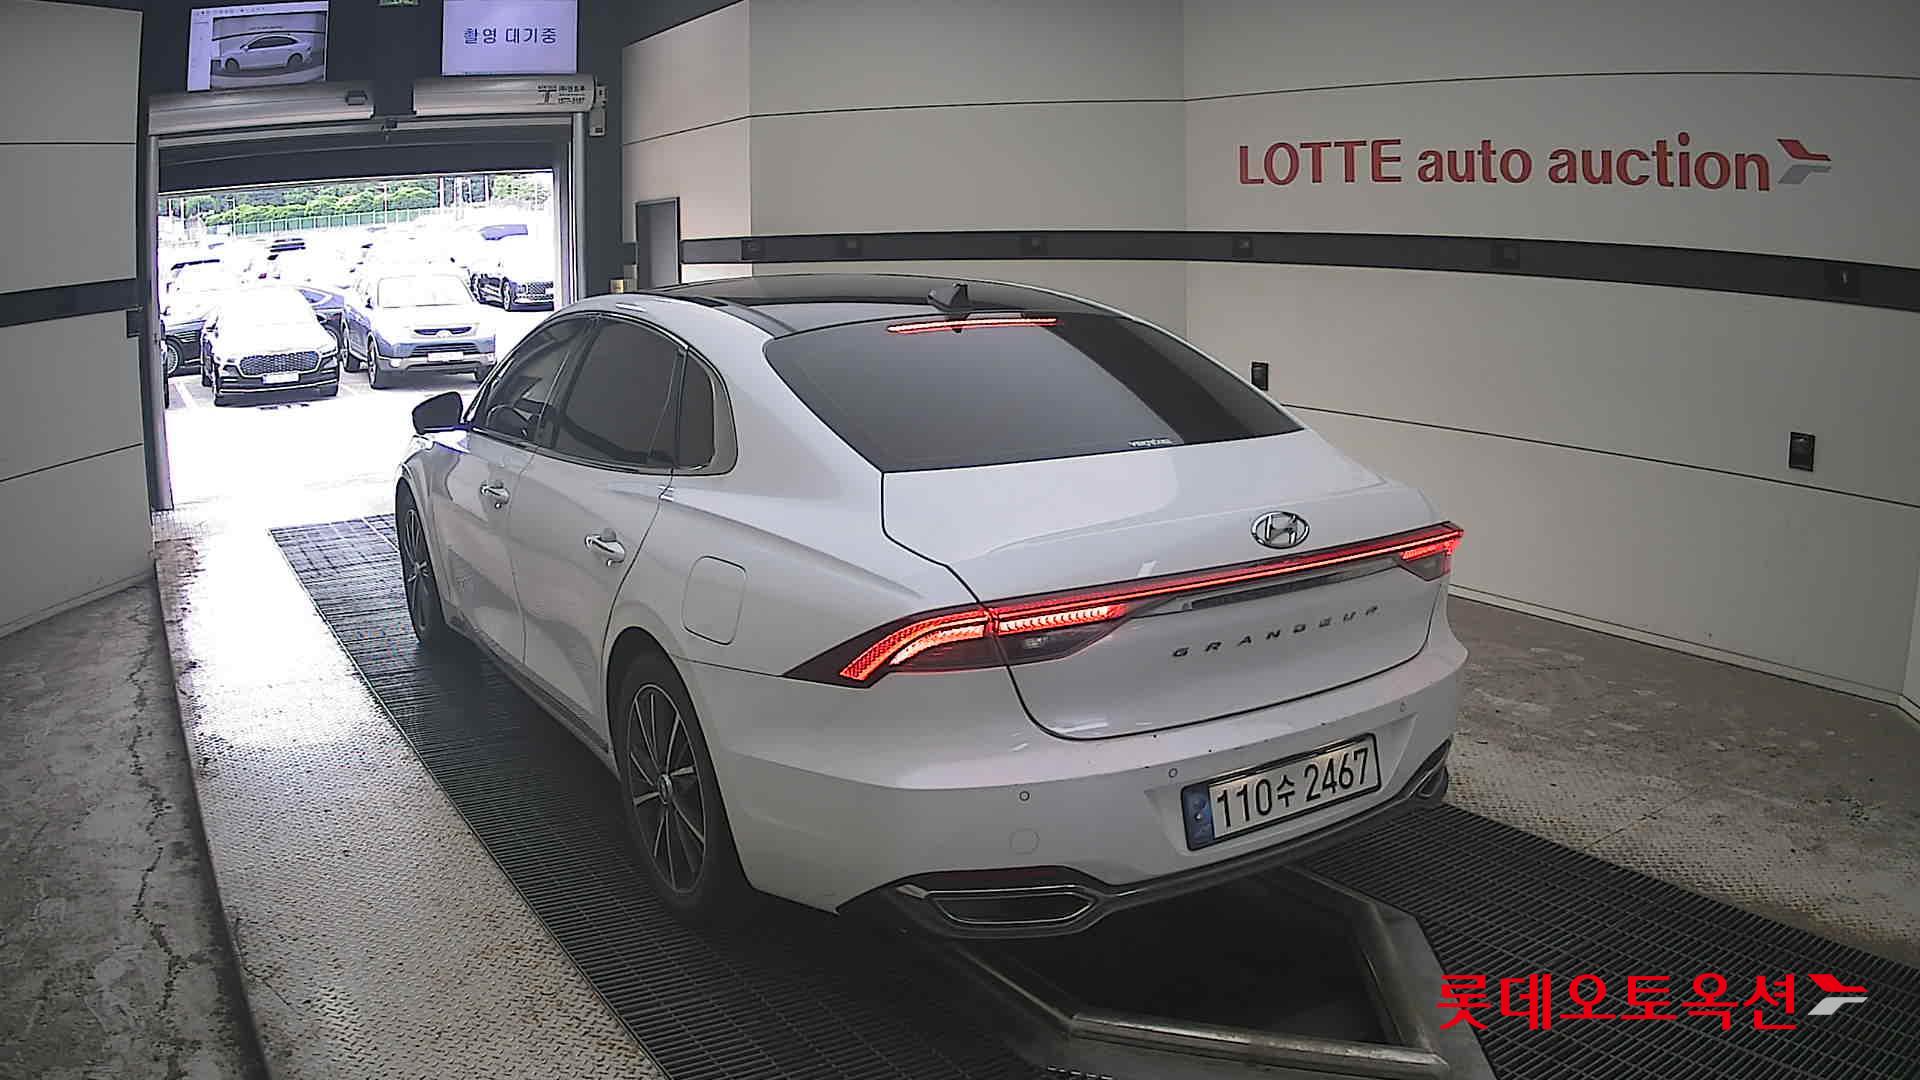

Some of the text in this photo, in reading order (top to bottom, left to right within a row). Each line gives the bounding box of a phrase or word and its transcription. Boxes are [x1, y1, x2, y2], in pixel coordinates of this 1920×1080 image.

[464, 27, 557, 44] 촬영 대기중
[1239, 132, 1770, 191] LOTTE auto auction
[1172, 605, 1379, 657] GRANDEUR
[1216, 747, 1369, 828] 110수 2467
